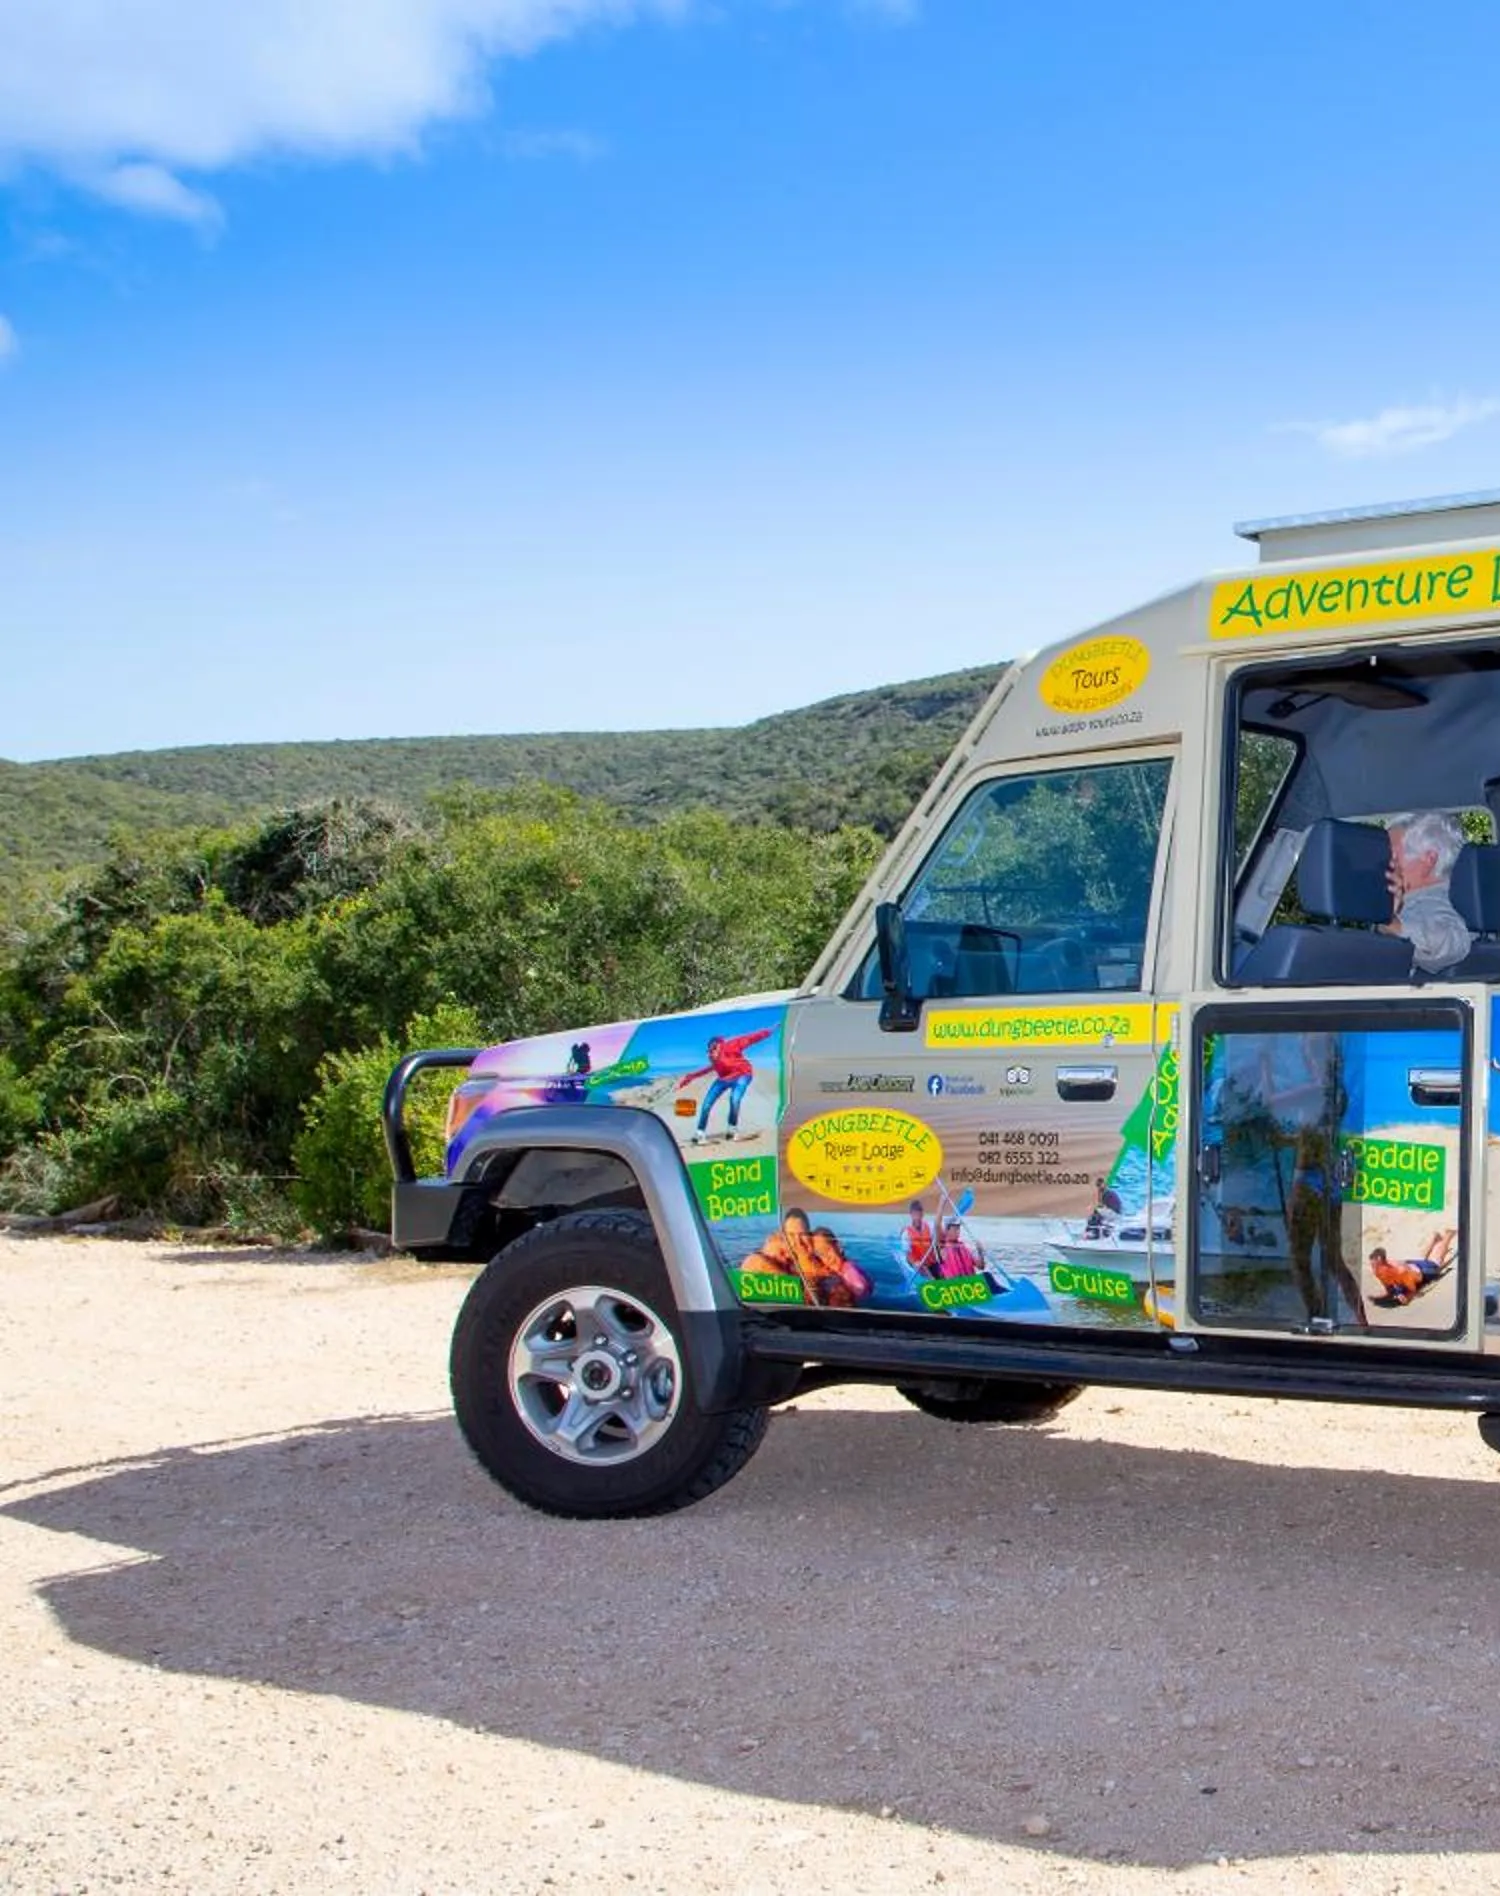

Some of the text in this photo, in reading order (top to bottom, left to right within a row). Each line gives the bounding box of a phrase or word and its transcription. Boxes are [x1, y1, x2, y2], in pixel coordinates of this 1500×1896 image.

[1219, 562, 1474, 628] Adventure
[1071, 667, 1121, 694] Tours
[932, 1014, 1132, 1041] www.dungbeetle.co.za
[798, 1113, 932, 1152] DUNGBEETLE
[978, 1131, 1060, 1147] 041 468 0091
[824, 1141, 905, 1162] River Lodge
[978, 1151, 1001, 1165] 082
[711, 1161, 762, 1191] Sand
[1351, 1170, 1433, 1204] Board
[706, 1192, 771, 1222] Board
[740, 1273, 800, 1299] Swim
[921, 1281, 988, 1308] Canoe
[1052, 1265, 1129, 1298] Cruise
